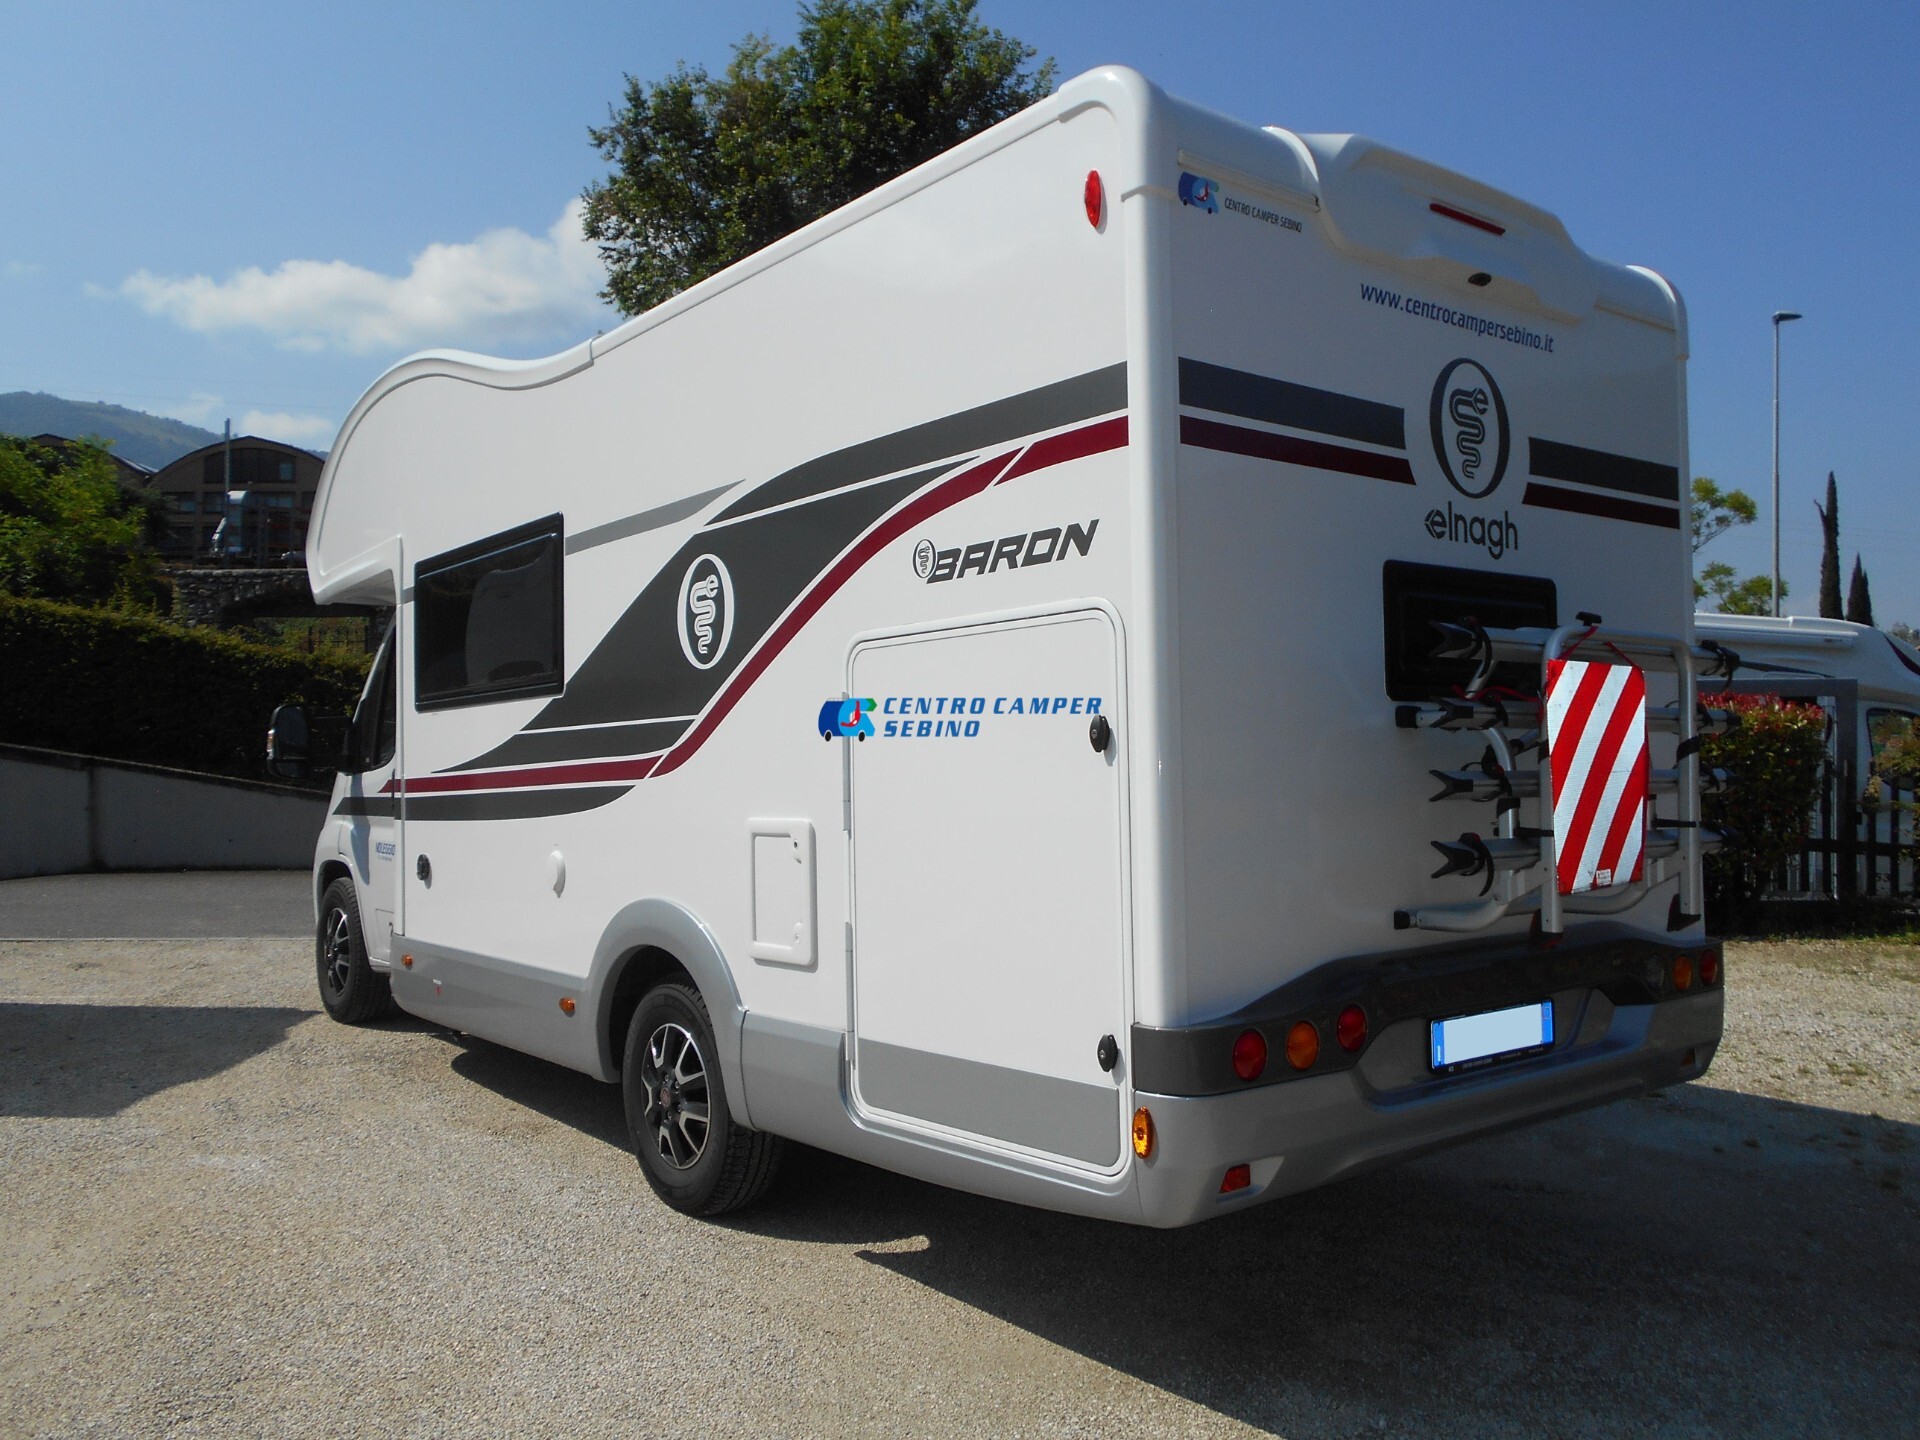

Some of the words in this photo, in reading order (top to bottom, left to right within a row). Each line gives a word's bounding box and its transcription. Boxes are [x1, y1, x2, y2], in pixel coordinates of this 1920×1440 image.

[1224, 197, 1251, 216] CENTRO
[1252, 207, 1279, 226] CAMPER
[1280, 216, 1303, 233] SEBINO
[1360, 283, 1554, 353] www.centrocampersebino.it
[926, 518, 1100, 584] BARON
[1424, 501, 1518, 560] elnagh
[883, 697, 986, 715] CENTRO
[993, 697, 1102, 715] CAMPER
[883, 720, 981, 738] SEBINO
